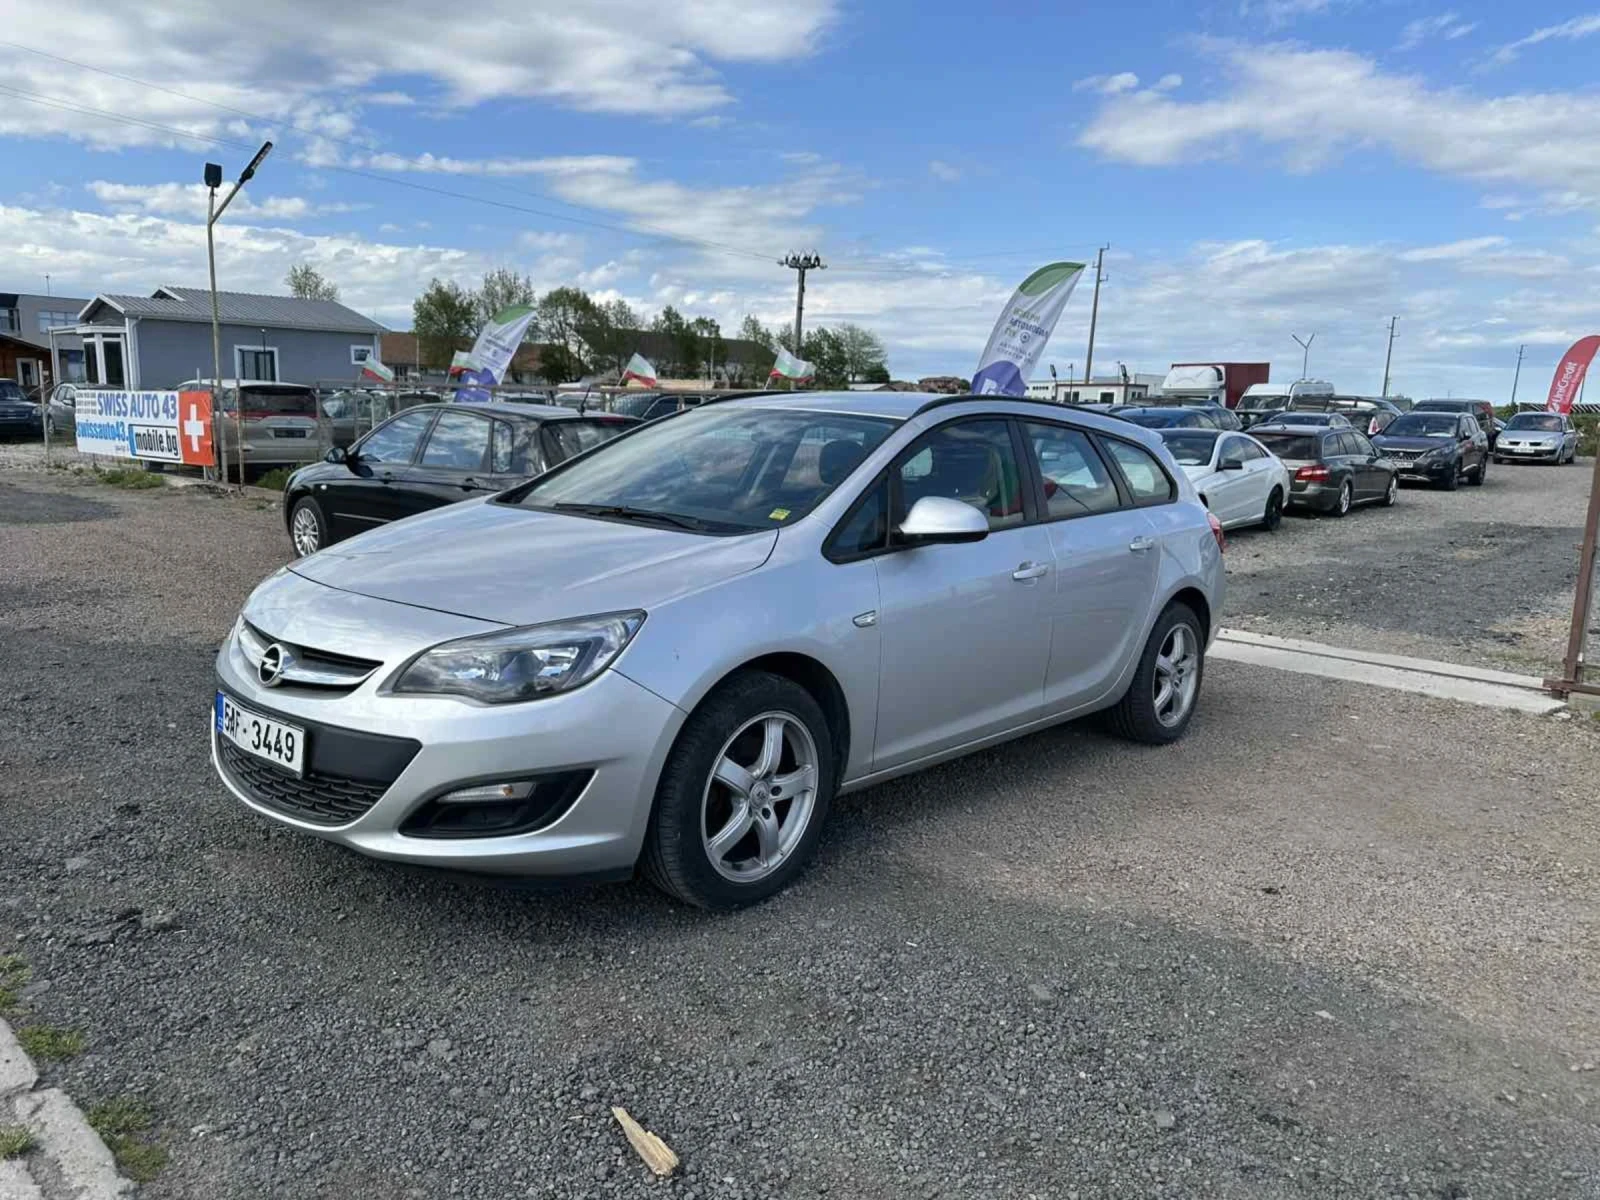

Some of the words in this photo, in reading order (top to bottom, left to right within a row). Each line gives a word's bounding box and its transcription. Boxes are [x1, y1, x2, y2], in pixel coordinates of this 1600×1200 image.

[97, 392, 128, 417] SWISS
[130, 394, 160, 418] AUTO
[162, 394, 177, 419] 43
[135, 429, 179, 456] mobile.bg
[252, 719, 295, 763] 3449
